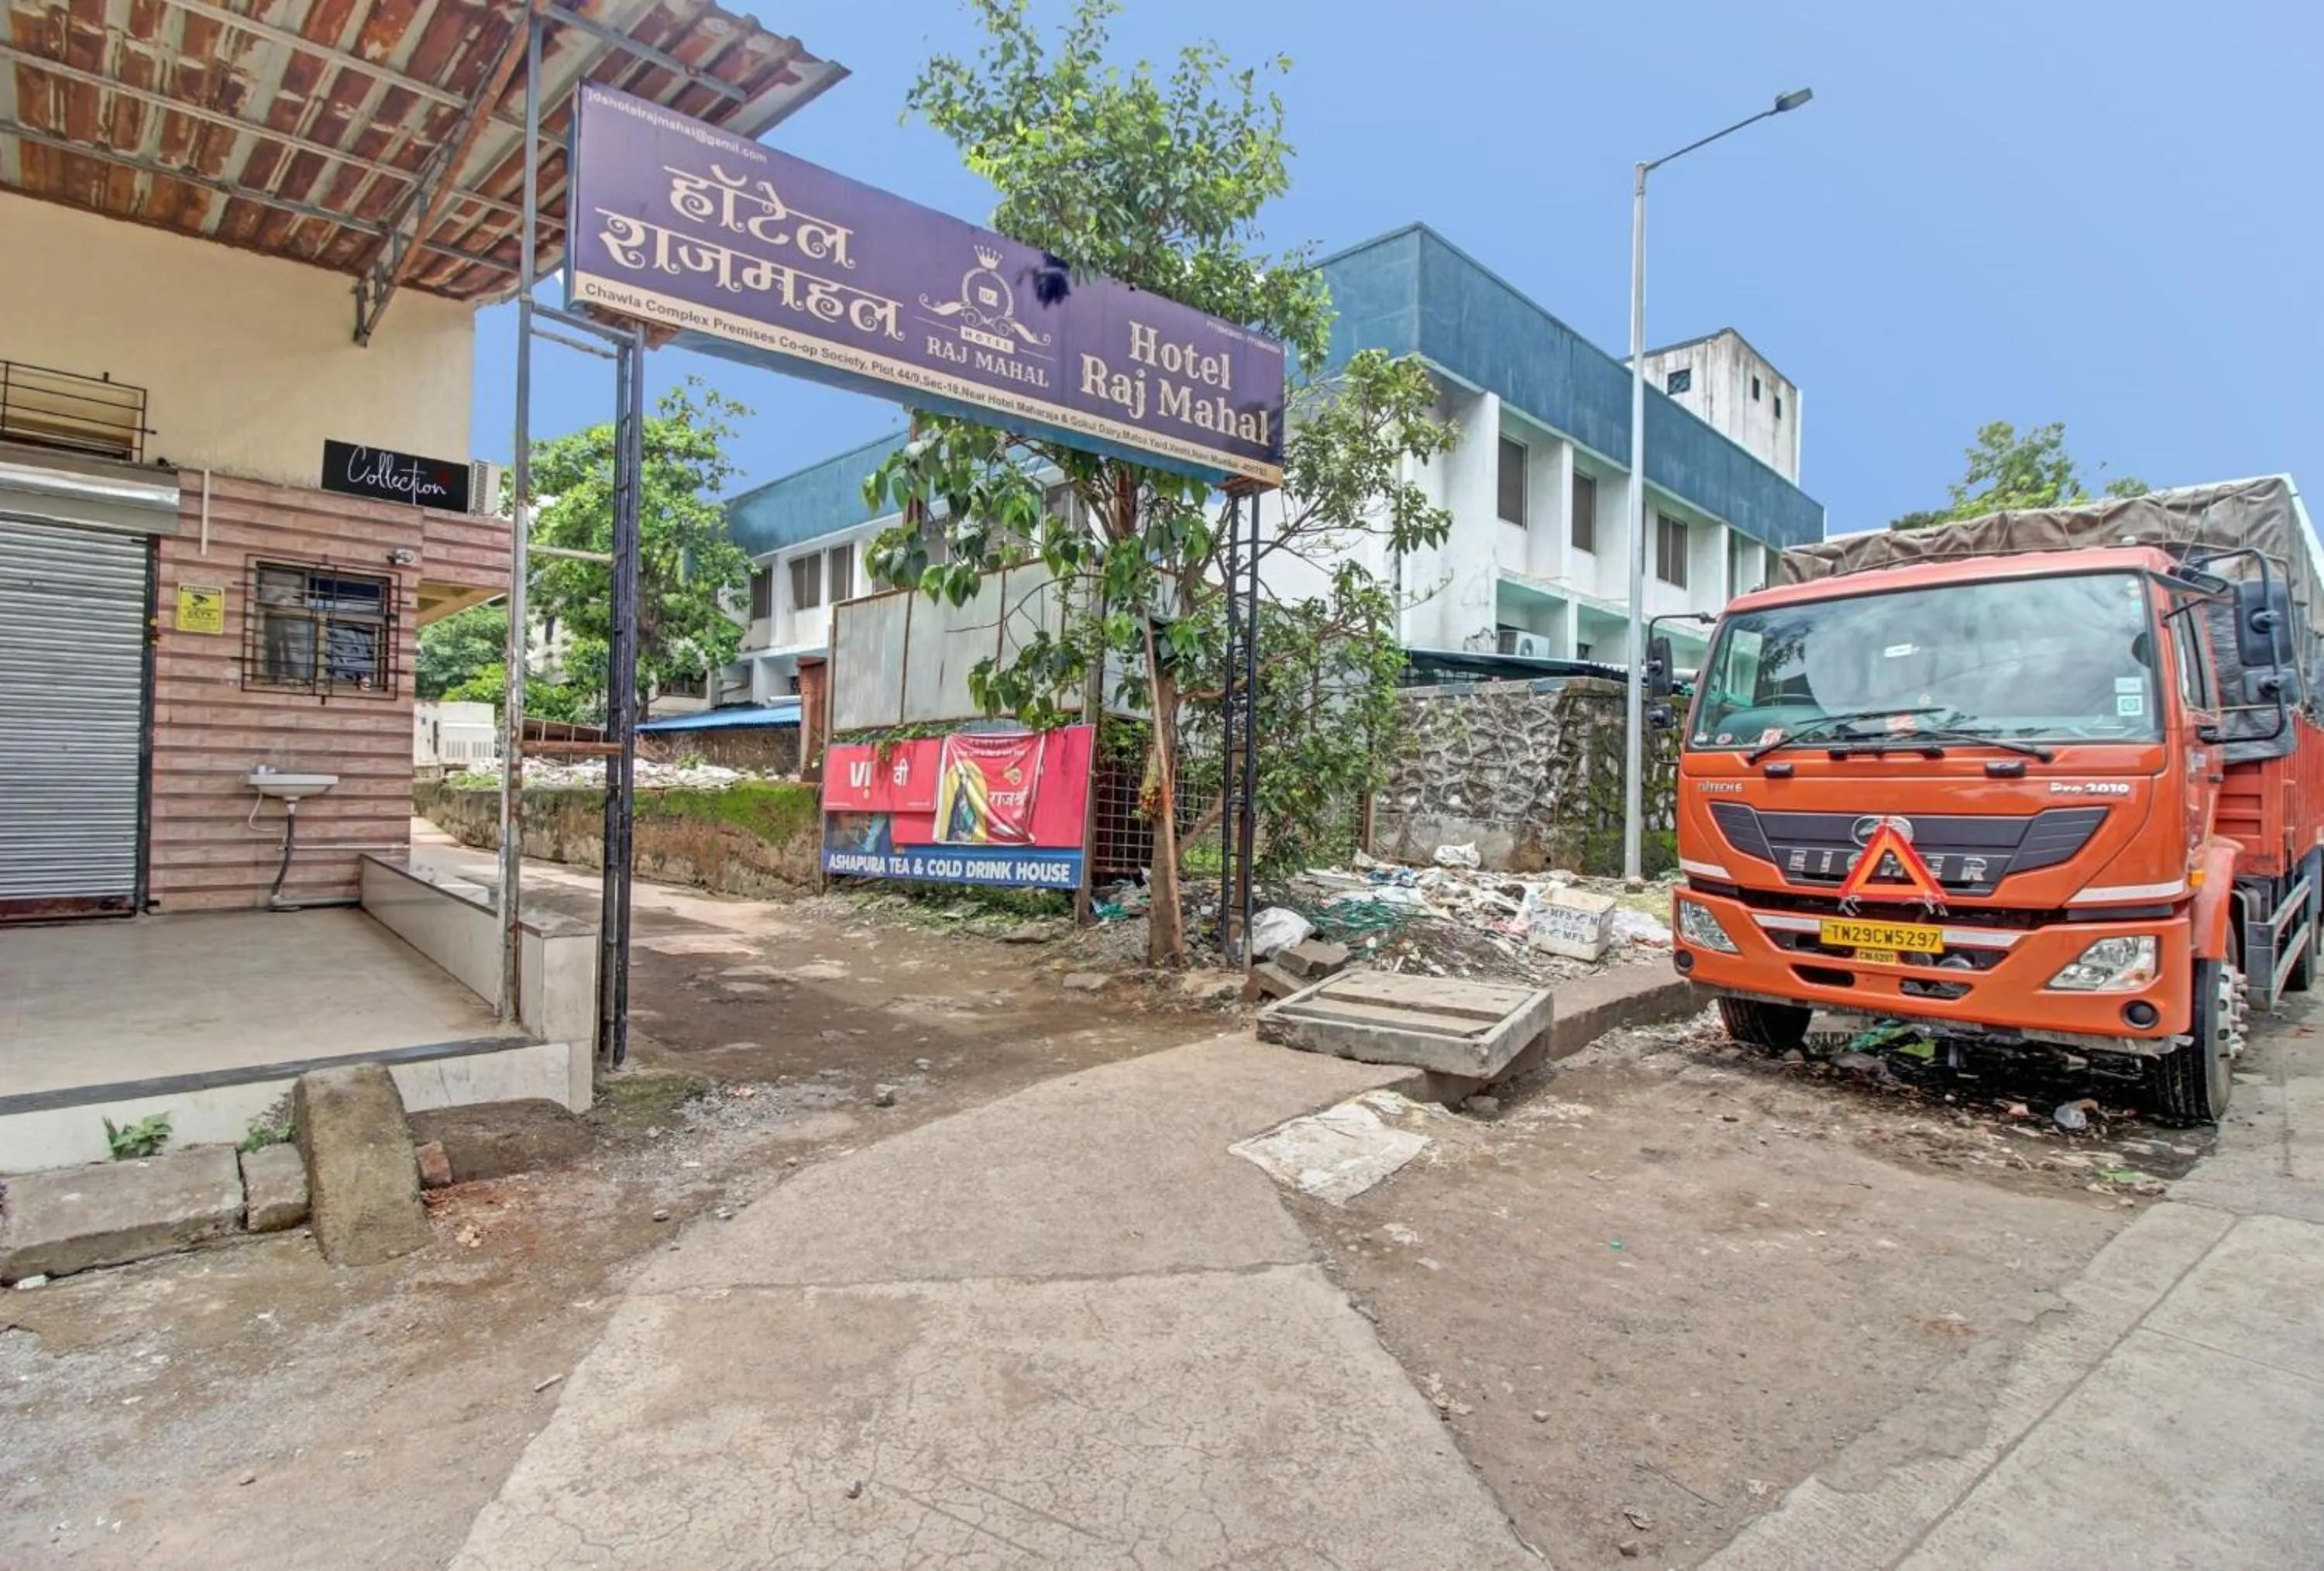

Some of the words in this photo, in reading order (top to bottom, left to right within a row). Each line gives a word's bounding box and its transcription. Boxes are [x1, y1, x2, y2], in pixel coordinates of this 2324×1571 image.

[663, 163, 856, 269] हॉटेल
[595, 207, 905, 342] राजमहल
[585, 284, 641, 308] Chawla
[645, 299, 710, 326] Complex
[713, 317, 775, 344] Premises
[779, 335, 818, 357] Co-op
[871, 361, 895, 376] Plot
[988, 394, 1014, 410] Hotel
[927, 336, 968, 363] RAJ
[975, 351, 1050, 388] MAHAL
[964, 330, 1008, 349] HOTEL
[1129, 320, 1232, 390] Hotel
[1080, 353, 1147, 419] Raj
[1157, 378, 1270, 447] Mahal
[347, 445, 447, 505] Collection
[829, 854, 885, 874] ASHAPURA
[889, 857, 909, 875] TEA
[913, 858, 924, 875] &
[927, 859, 963, 878] COLD
[965, 860, 1012, 880] DRINK
[1016, 861, 1071, 883] HOUSE
[1831, 924, 1938, 949] TN29CW5297
